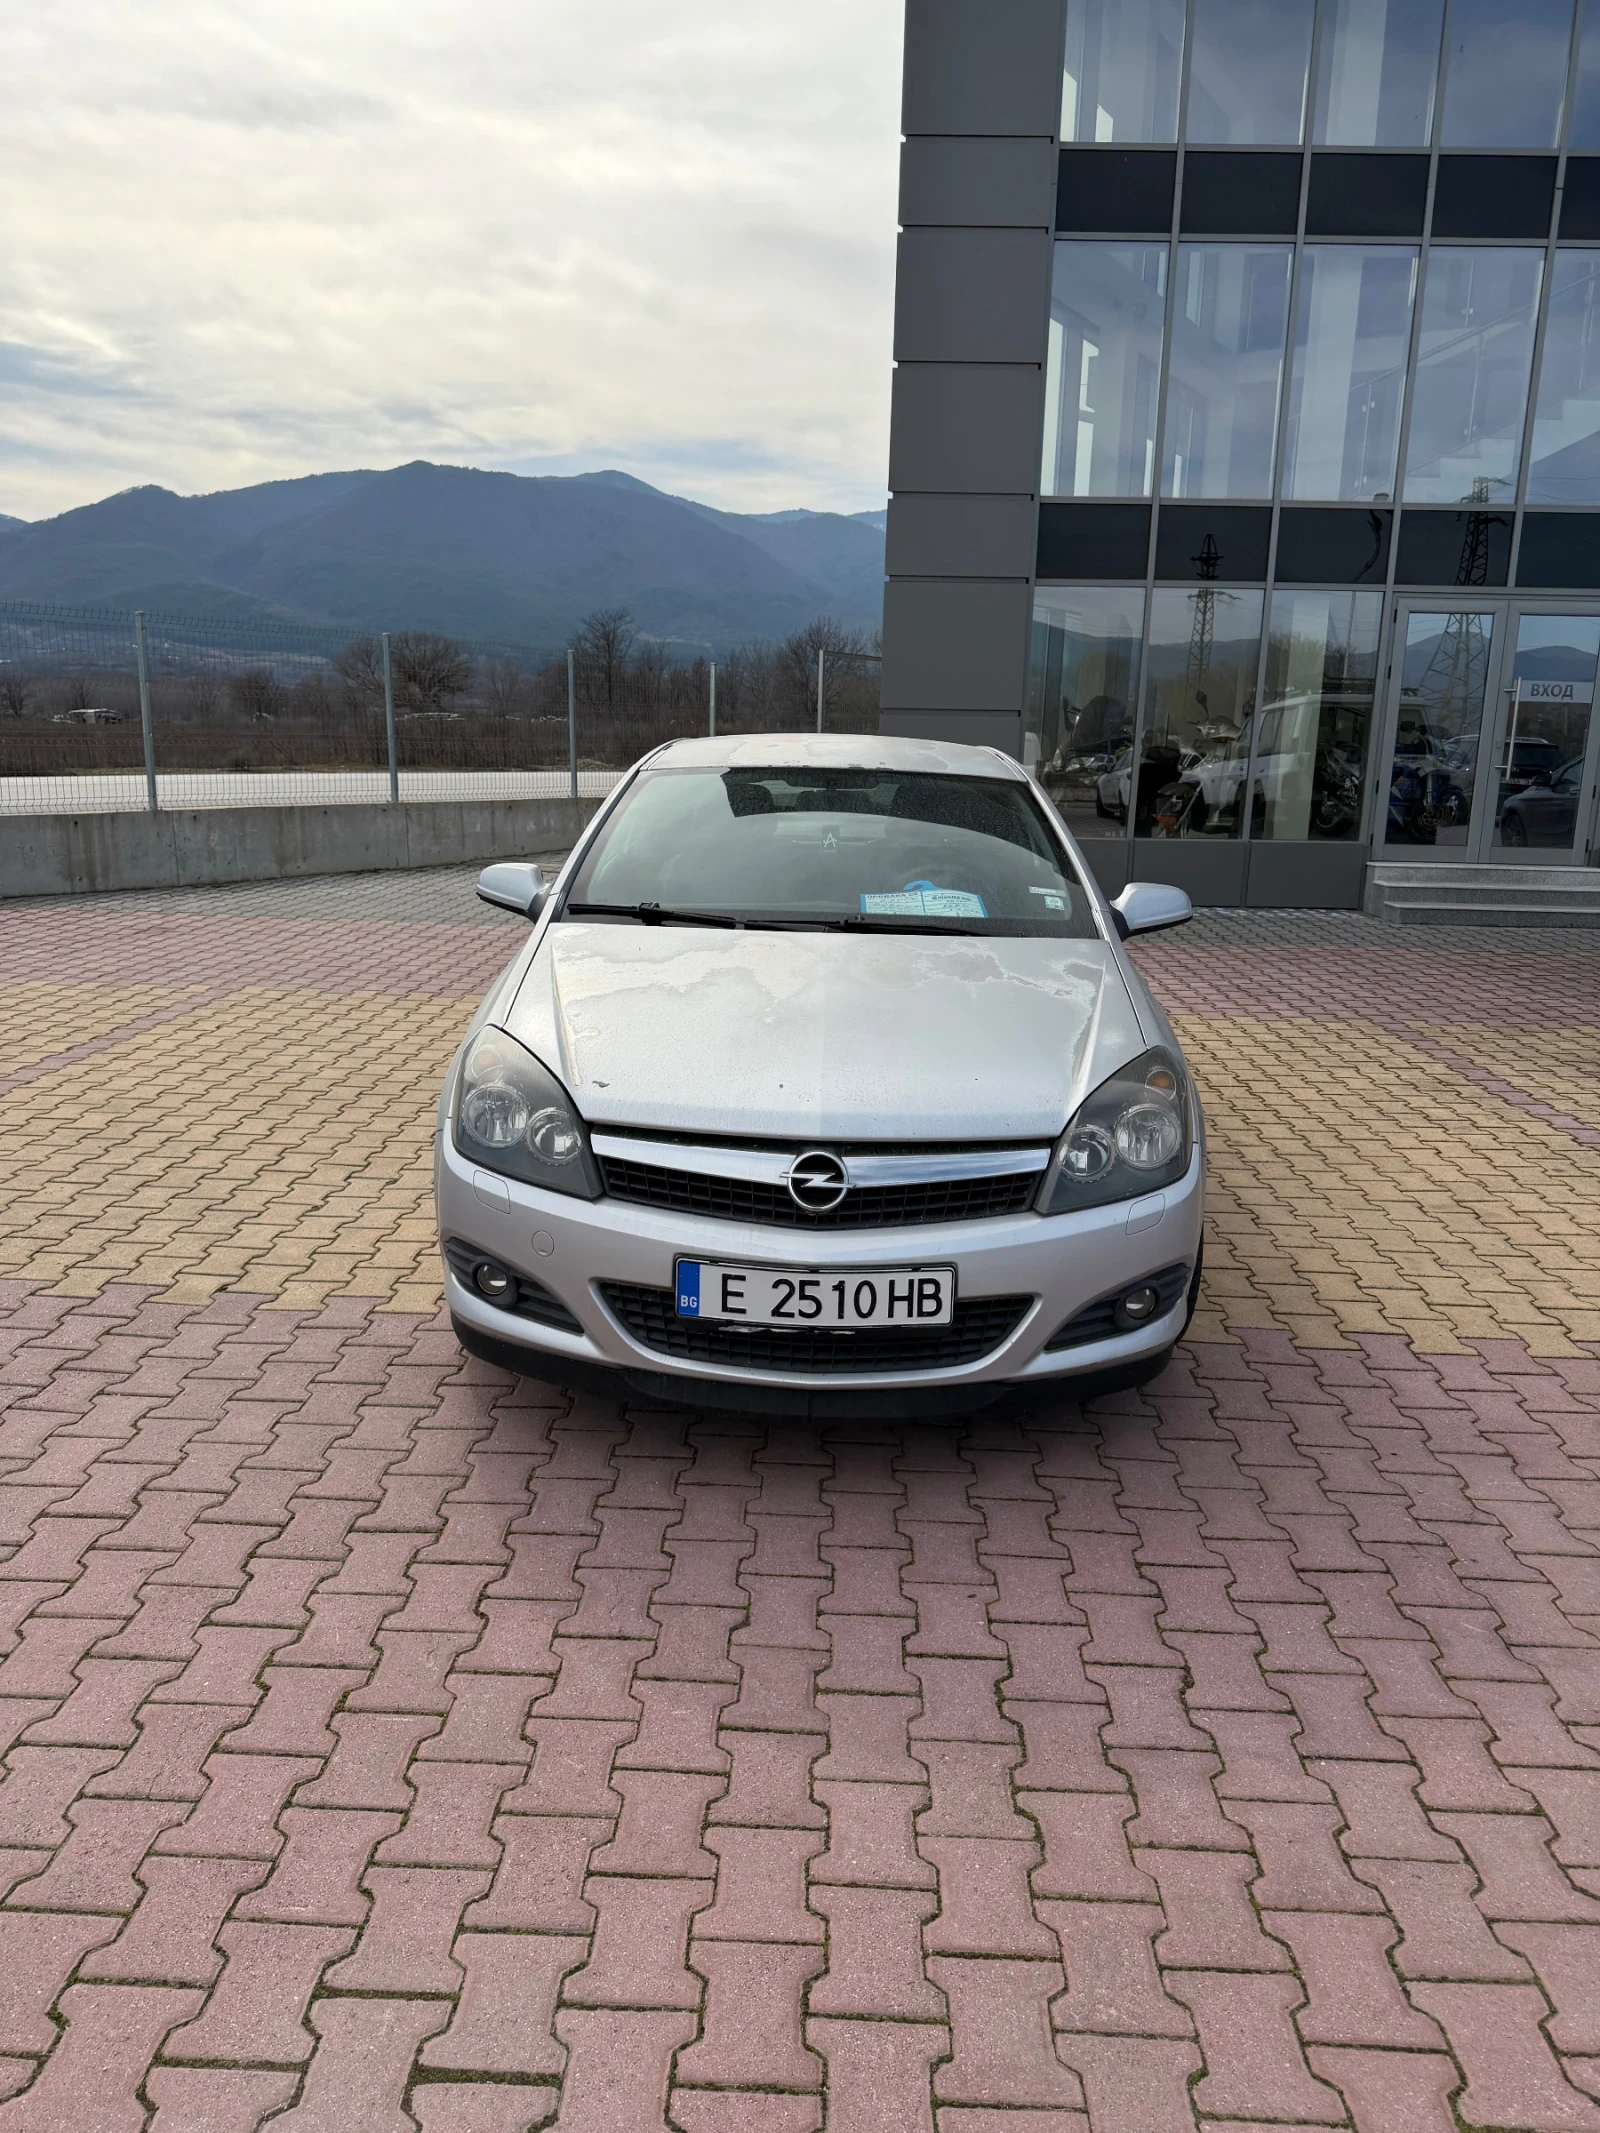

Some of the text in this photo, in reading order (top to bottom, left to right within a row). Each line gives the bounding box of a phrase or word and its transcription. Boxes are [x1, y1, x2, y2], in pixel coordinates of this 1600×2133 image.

[1530, 683, 1574, 700] ВХОД
[680, 1295, 698, 1308] BG
[721, 1273, 943, 1319] E 2510 HB
